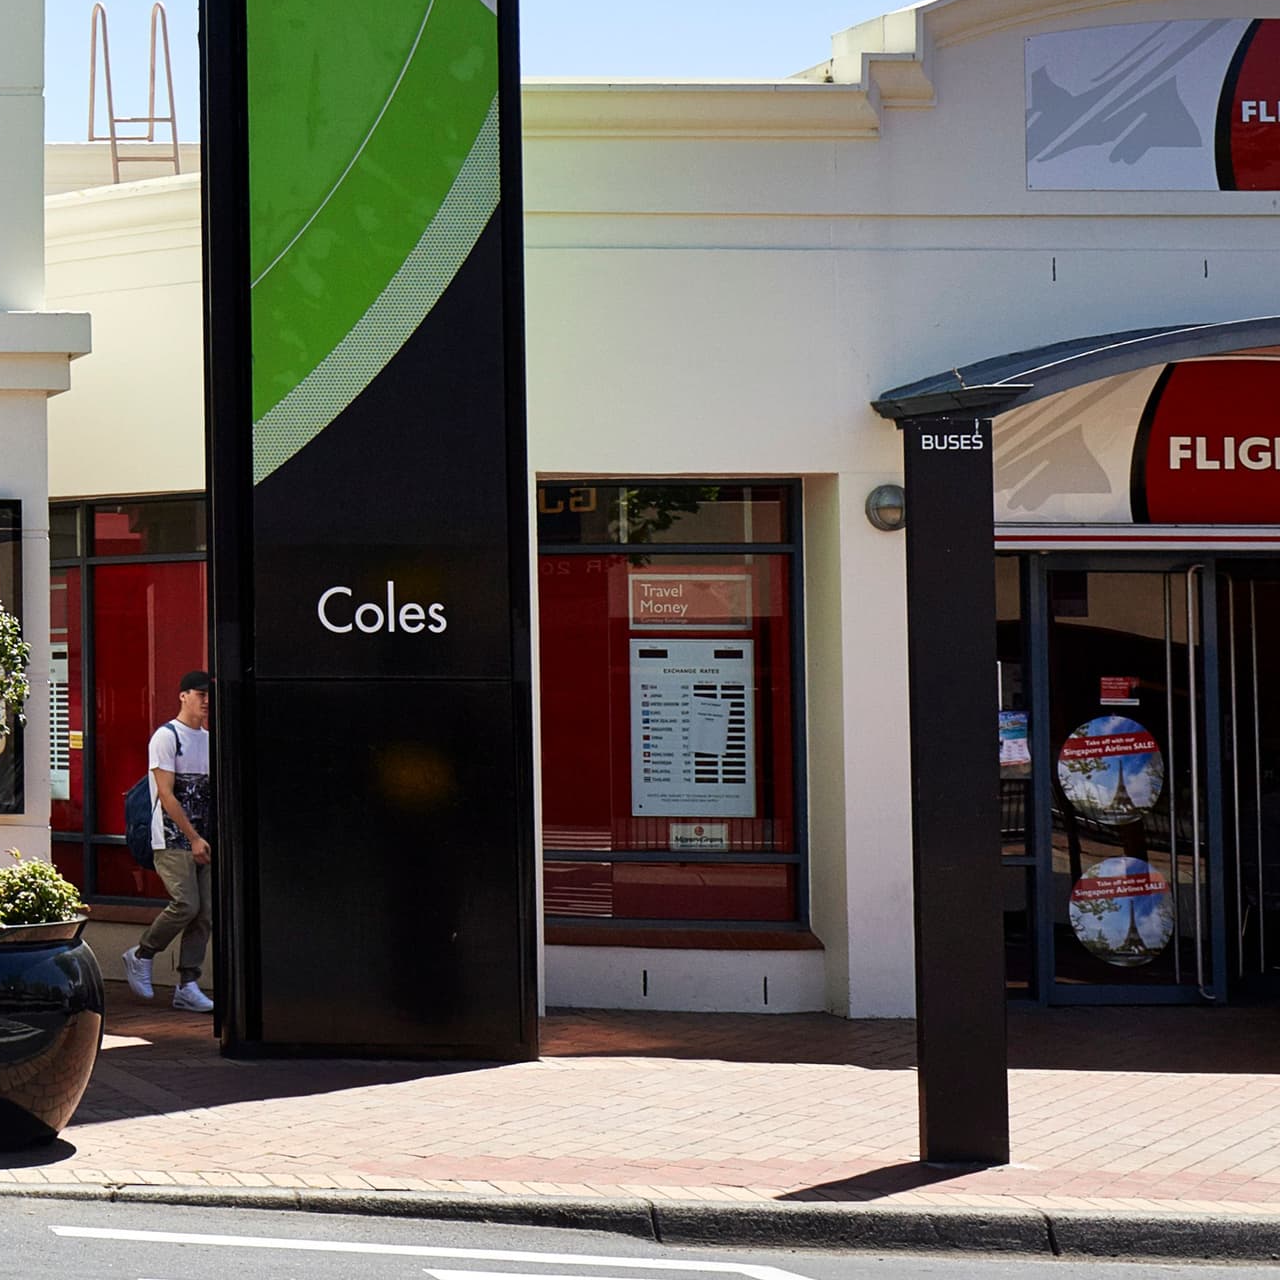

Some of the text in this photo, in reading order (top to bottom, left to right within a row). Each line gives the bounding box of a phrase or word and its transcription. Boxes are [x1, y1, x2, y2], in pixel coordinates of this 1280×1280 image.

[1242, 101, 1280, 122] FL
[921, 434, 984, 450] BUSES
[1169, 436, 1280, 470] FLIG
[640, 584, 683, 598] Travel
[317, 580, 448, 633] Coles
[640, 600, 689, 617] Money
[1063, 746, 1103, 757] Singapore
[1105, 744, 1132, 753] Airlines
[1074, 888, 1115, 898] Singapore
[1116, 886, 1144, 894] Airlines
